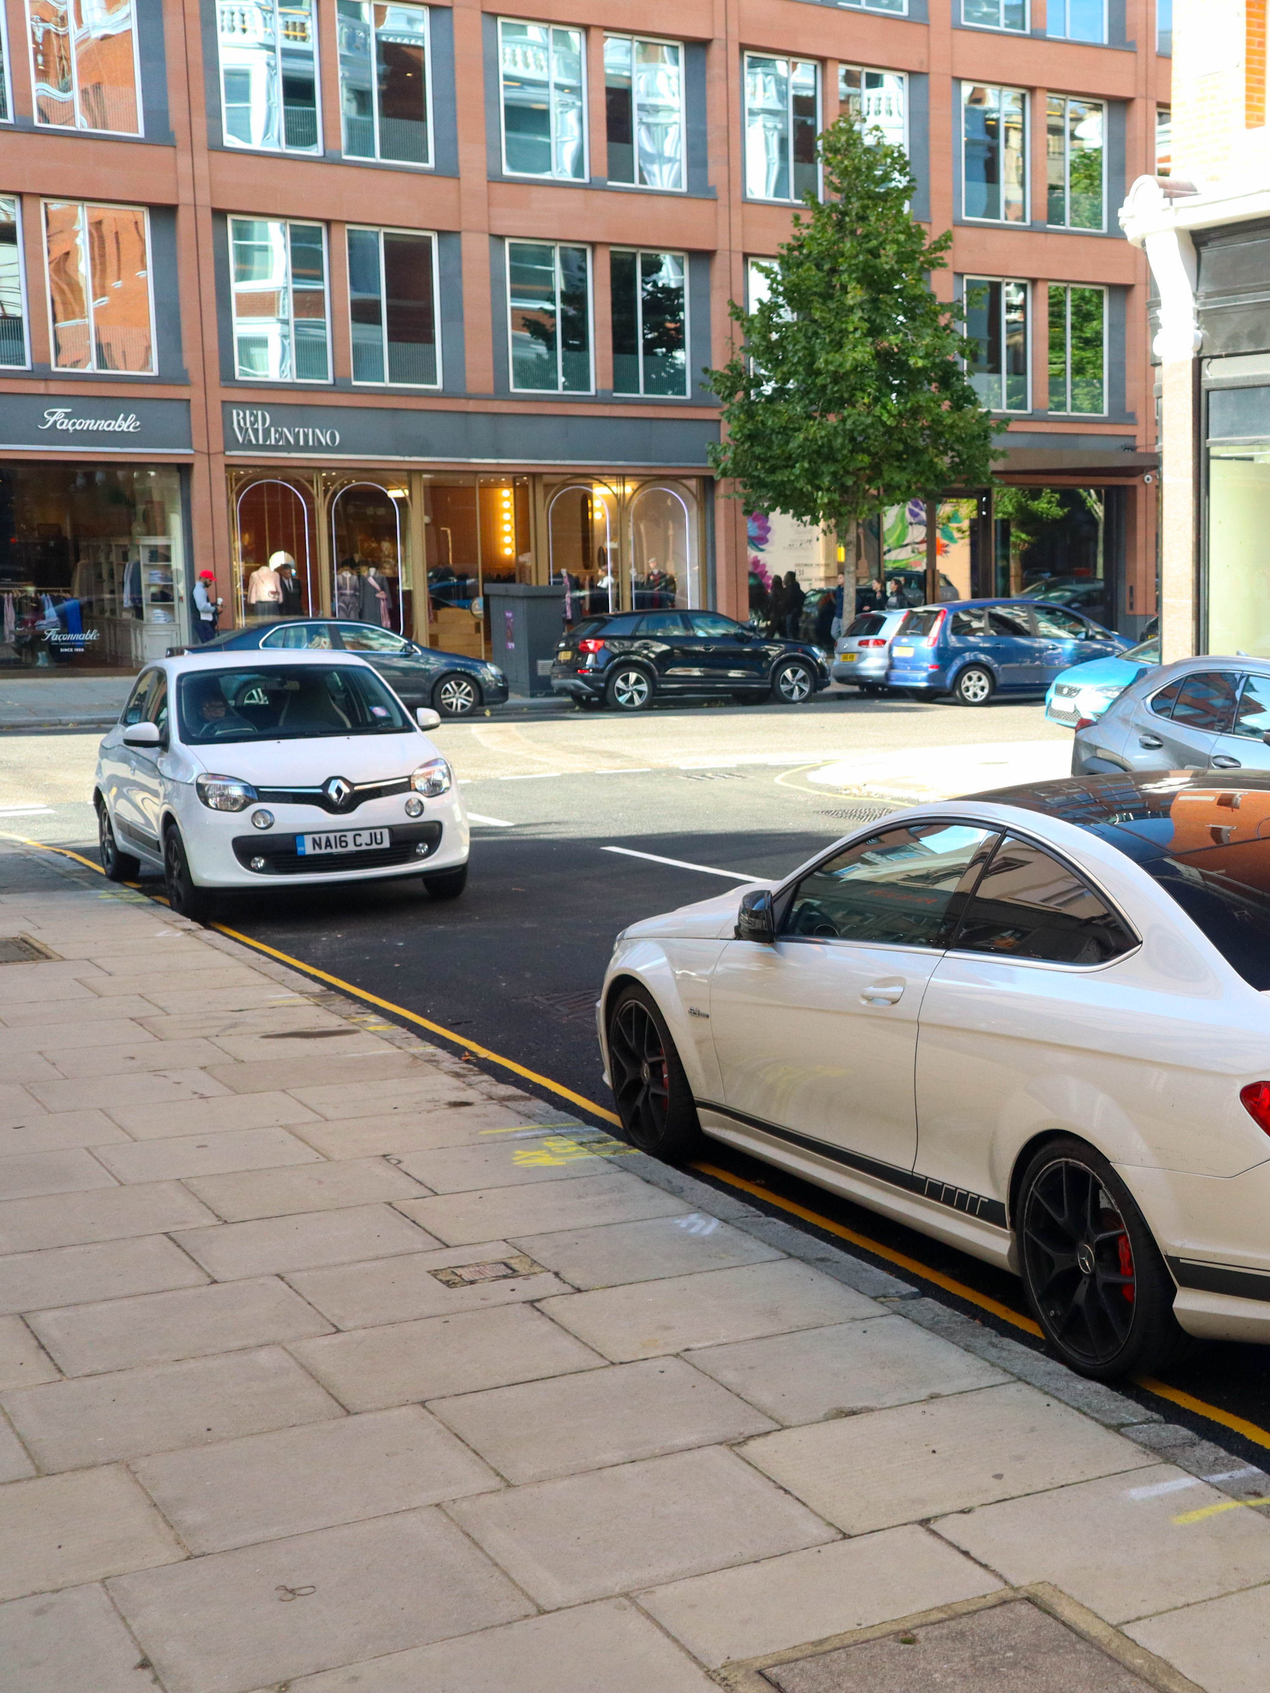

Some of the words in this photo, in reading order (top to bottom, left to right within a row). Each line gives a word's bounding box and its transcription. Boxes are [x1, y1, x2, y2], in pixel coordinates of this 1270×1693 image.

[38, 408, 141, 433] Façonnable
[232, 409, 271, 428] RED
[232, 425, 340, 447] VALENTINO
[41, 628, 100, 642] Façonnable
[312, 834, 348, 851] NA16
[353, 831, 384, 847] CJU
